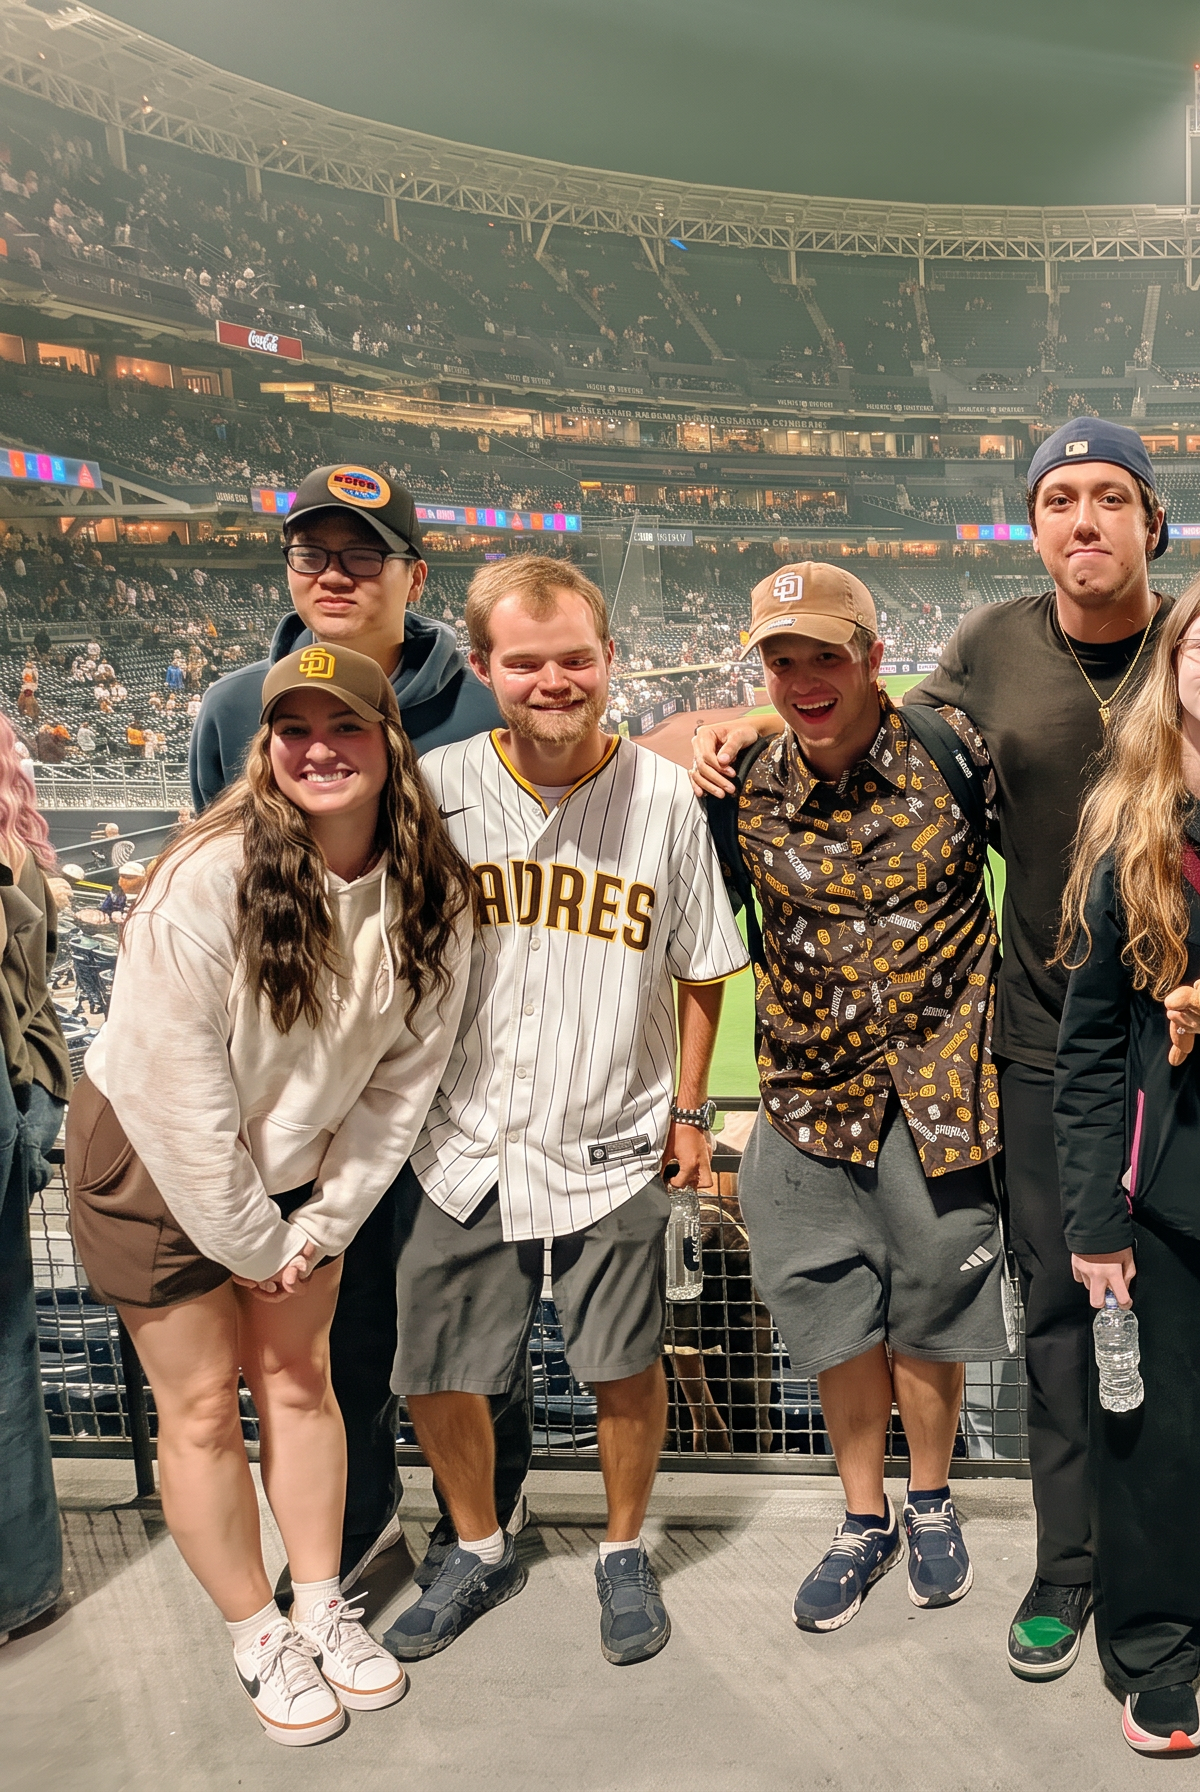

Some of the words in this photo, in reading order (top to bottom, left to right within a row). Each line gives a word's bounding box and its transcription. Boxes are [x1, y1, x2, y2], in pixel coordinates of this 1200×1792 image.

[773, 571, 805, 603] SD
[298, 646, 336, 679] SD
[473, 859, 656, 953] ADRES
